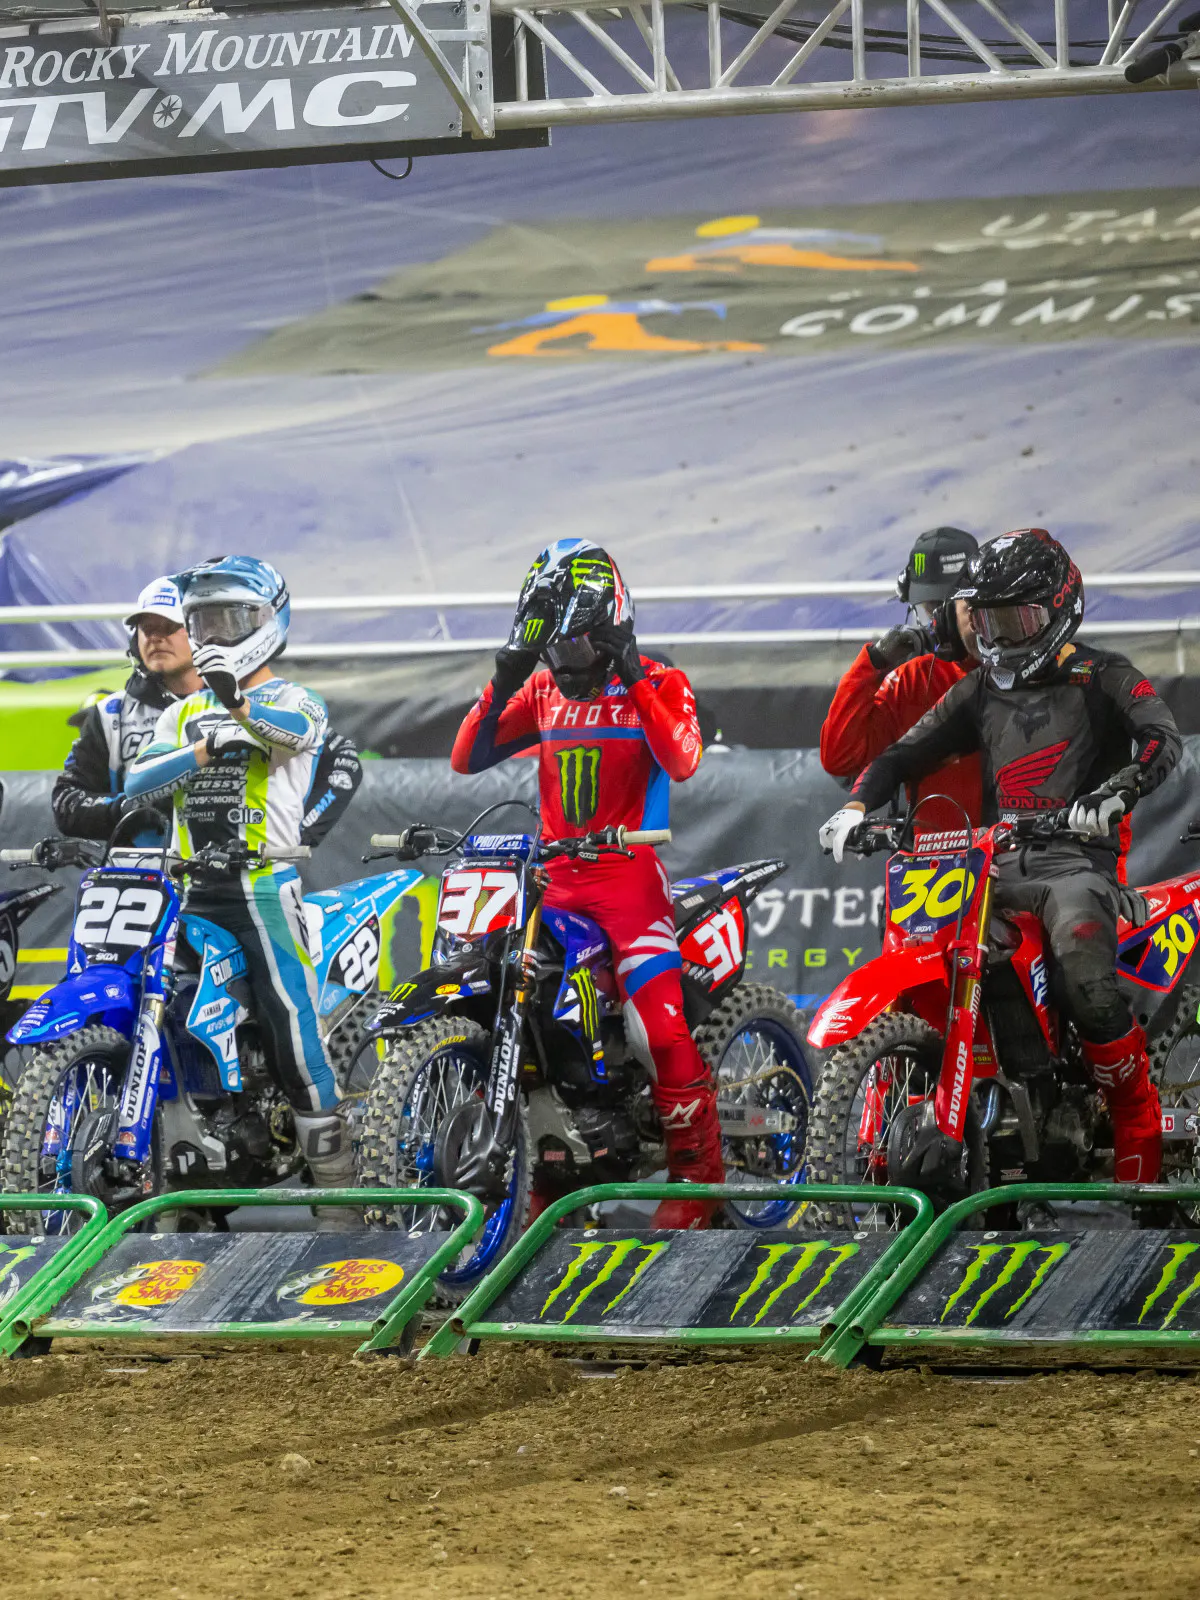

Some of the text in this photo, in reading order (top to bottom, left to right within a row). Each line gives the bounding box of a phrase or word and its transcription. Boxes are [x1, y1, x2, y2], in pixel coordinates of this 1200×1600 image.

[157, 24, 414, 77] MOUNTAIN
[551, 704, 624, 726] THOR
[998, 797, 1067, 809] HONDA
[917, 840, 971, 853] RENTHA
[918, 829, 971, 843] RENTHA
[73, 887, 164, 948] 22
[438, 871, 519, 935] 37
[890, 867, 976, 924] 30
[338, 926, 379, 992] 22
[692, 908, 743, 983] 37
[1153, 913, 1196, 978] 30
[126, 1043, 149, 1121] DUNLOP
[494, 1030, 514, 1116] DUNLOP
[948, 1040, 968, 1129] DUNLOP
[150, 1261, 201, 1275] Bass
[315, 1285, 381, 1301] Shops
[336, 1260, 388, 1274] Bass
